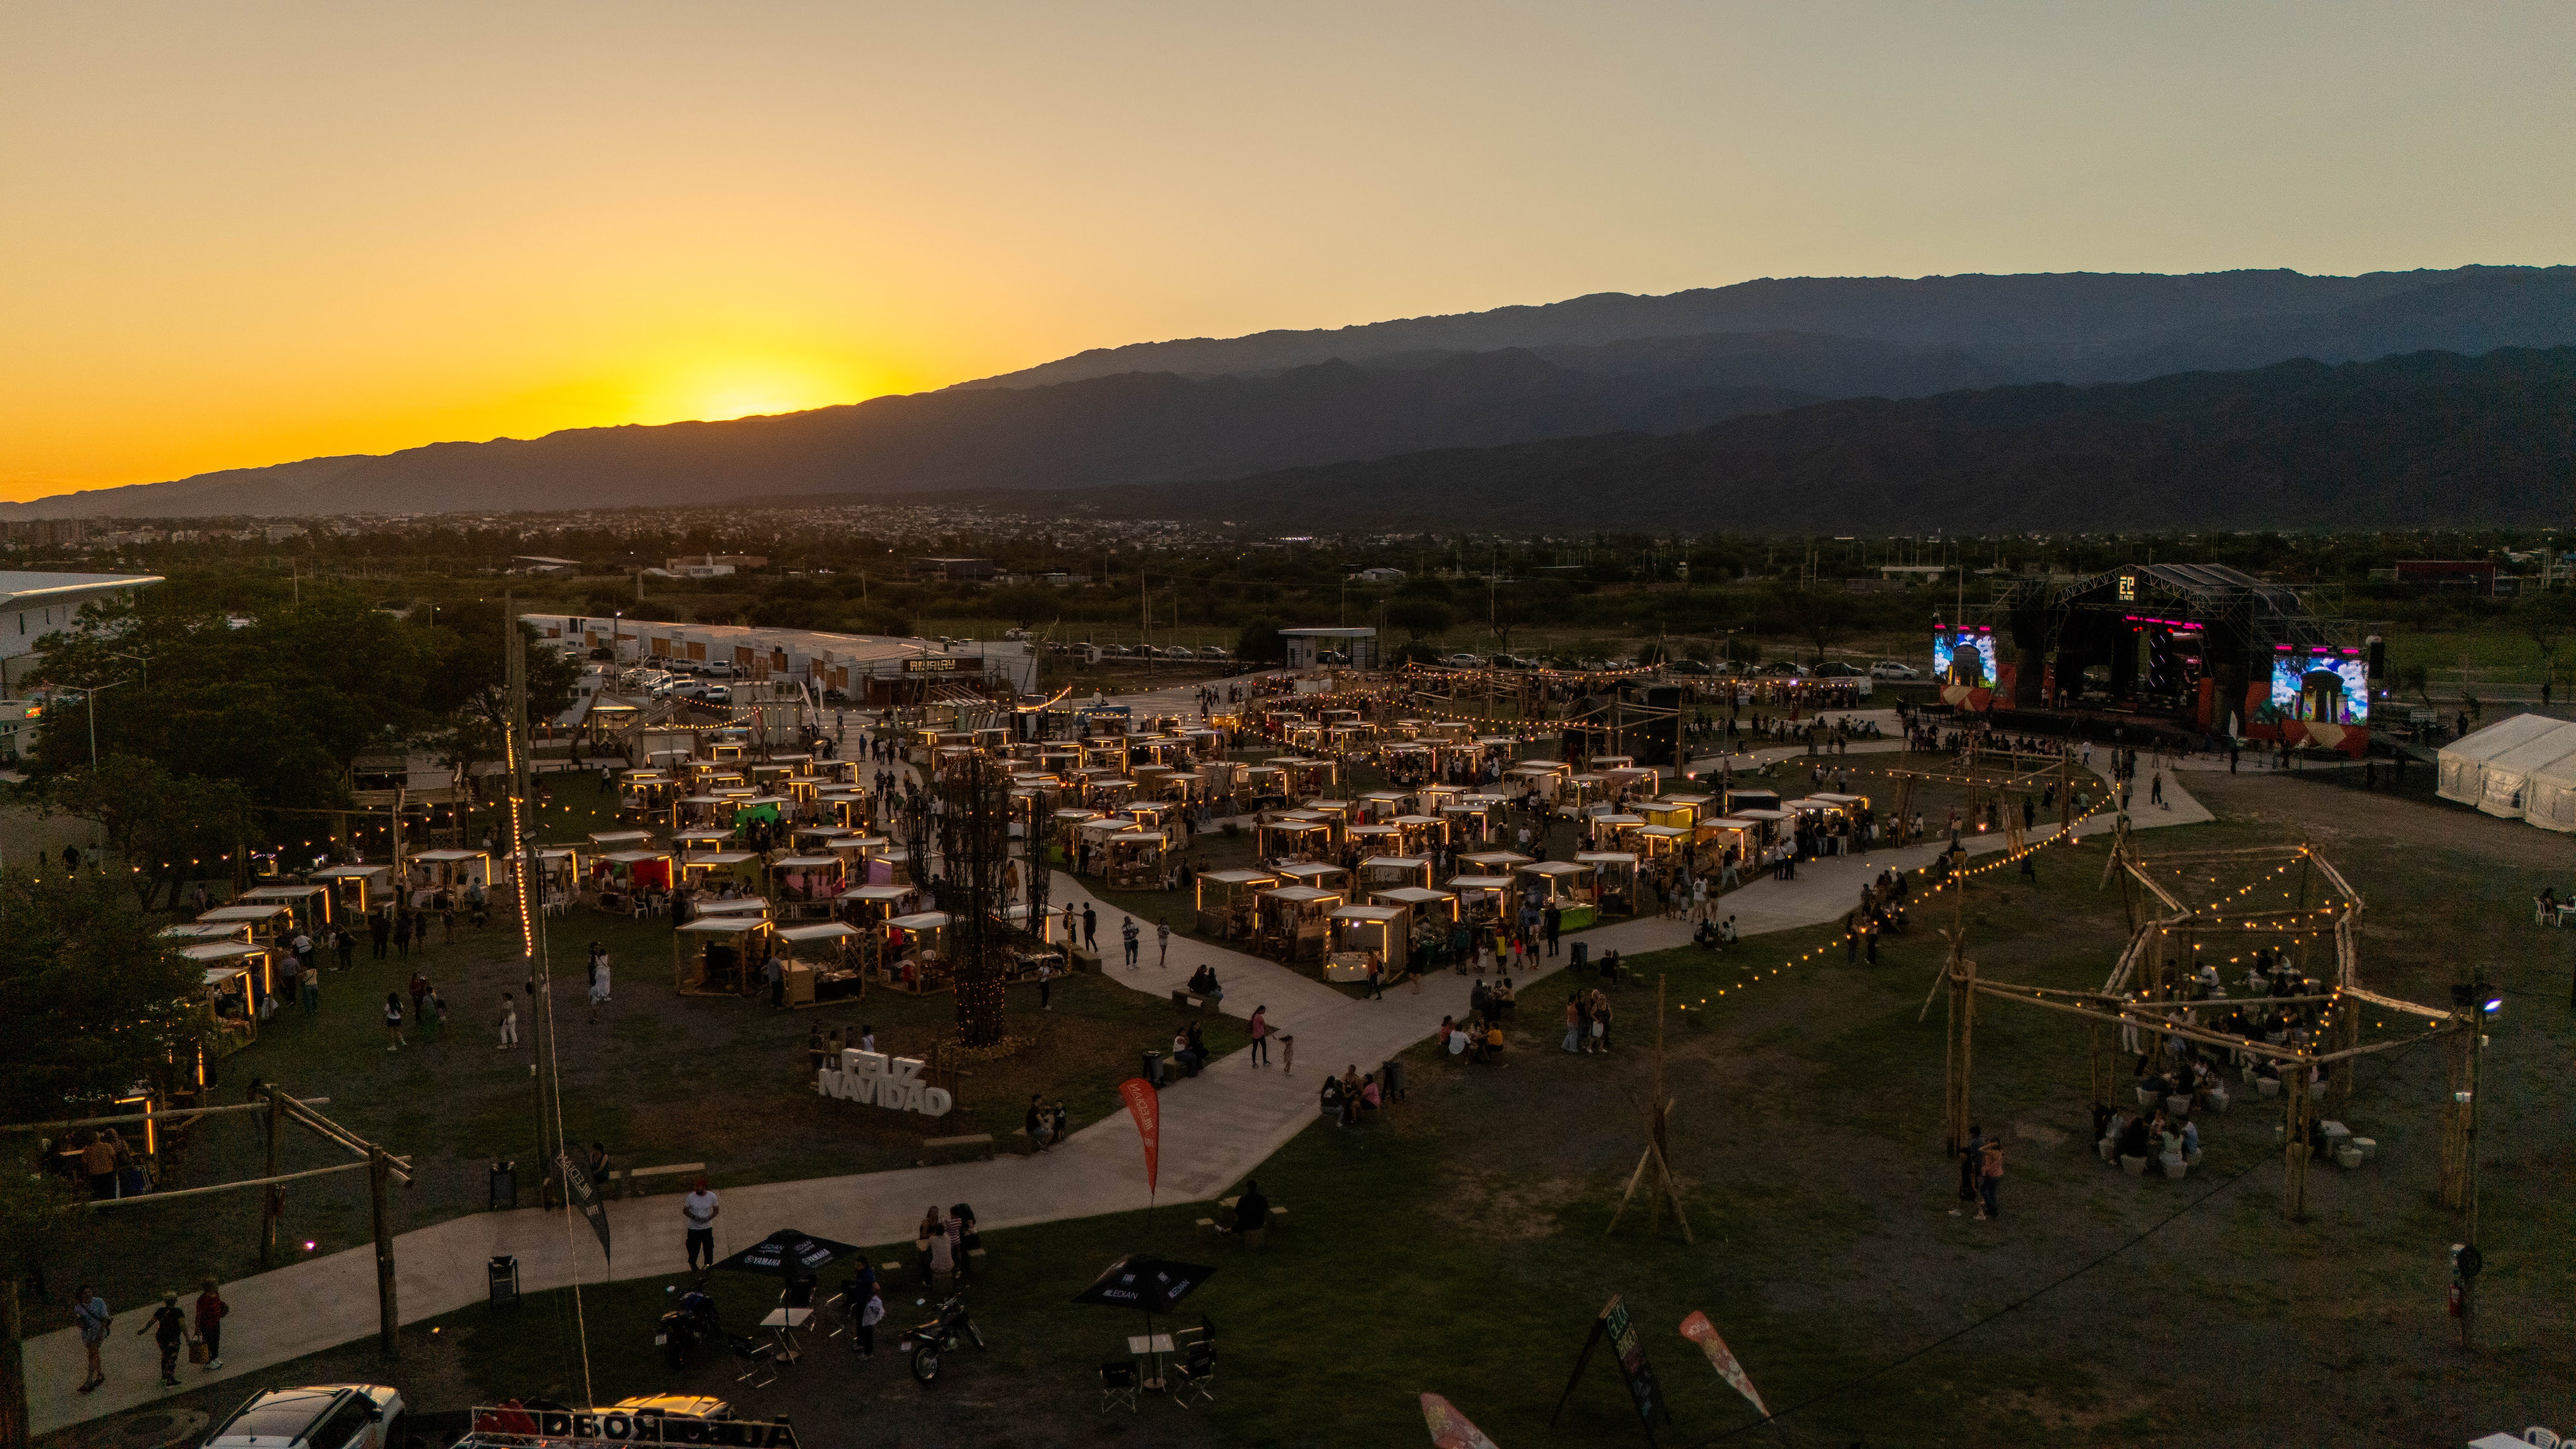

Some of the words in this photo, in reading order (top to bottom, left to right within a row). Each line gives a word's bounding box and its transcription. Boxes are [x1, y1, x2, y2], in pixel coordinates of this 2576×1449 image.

[842, 1048, 926, 1087] FELIZ
[818, 1067, 952, 1117] NAVIDAD
[754, 1256, 781, 1267] YAMAHA
